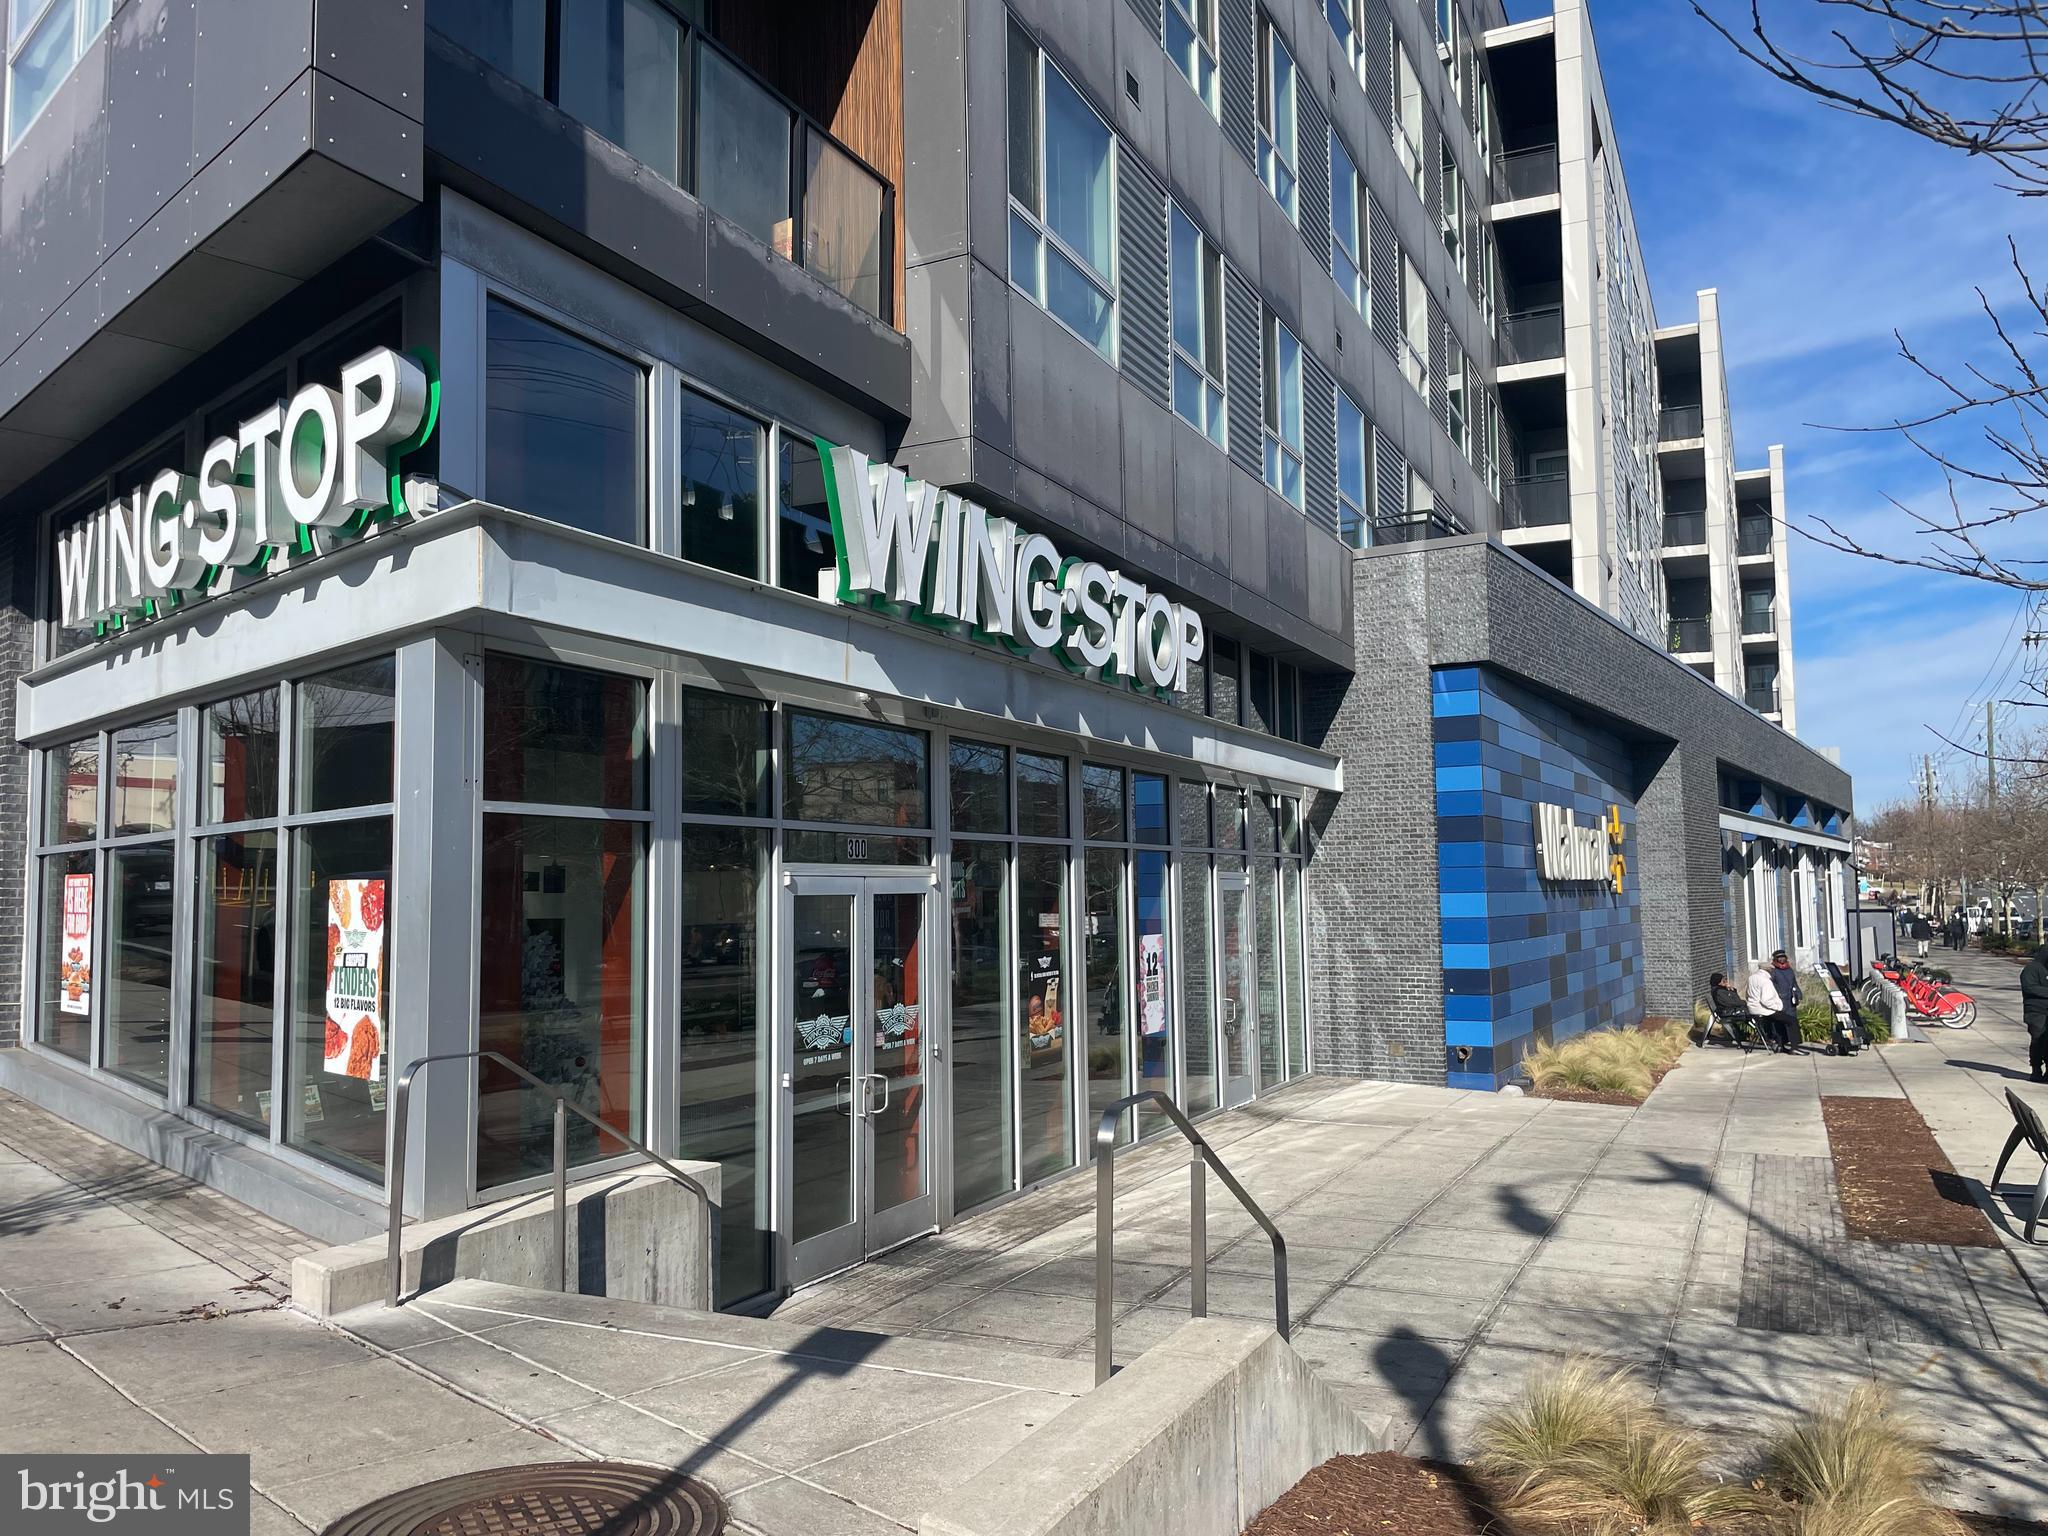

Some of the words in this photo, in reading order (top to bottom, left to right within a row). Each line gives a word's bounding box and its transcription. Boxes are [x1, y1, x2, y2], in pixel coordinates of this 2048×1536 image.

[848, 839, 866, 858] 300
[1538, 802, 1612, 881] Walmart
[1146, 952, 1159, 977] 12
[333, 966, 377, 998] TENDERS
[334, 998, 340, 1009] 12
[341, 999, 350, 1010] BIG
[351, 1000, 376, 1013] FLAVORS
[803, 1057, 814, 1066] OPEN
